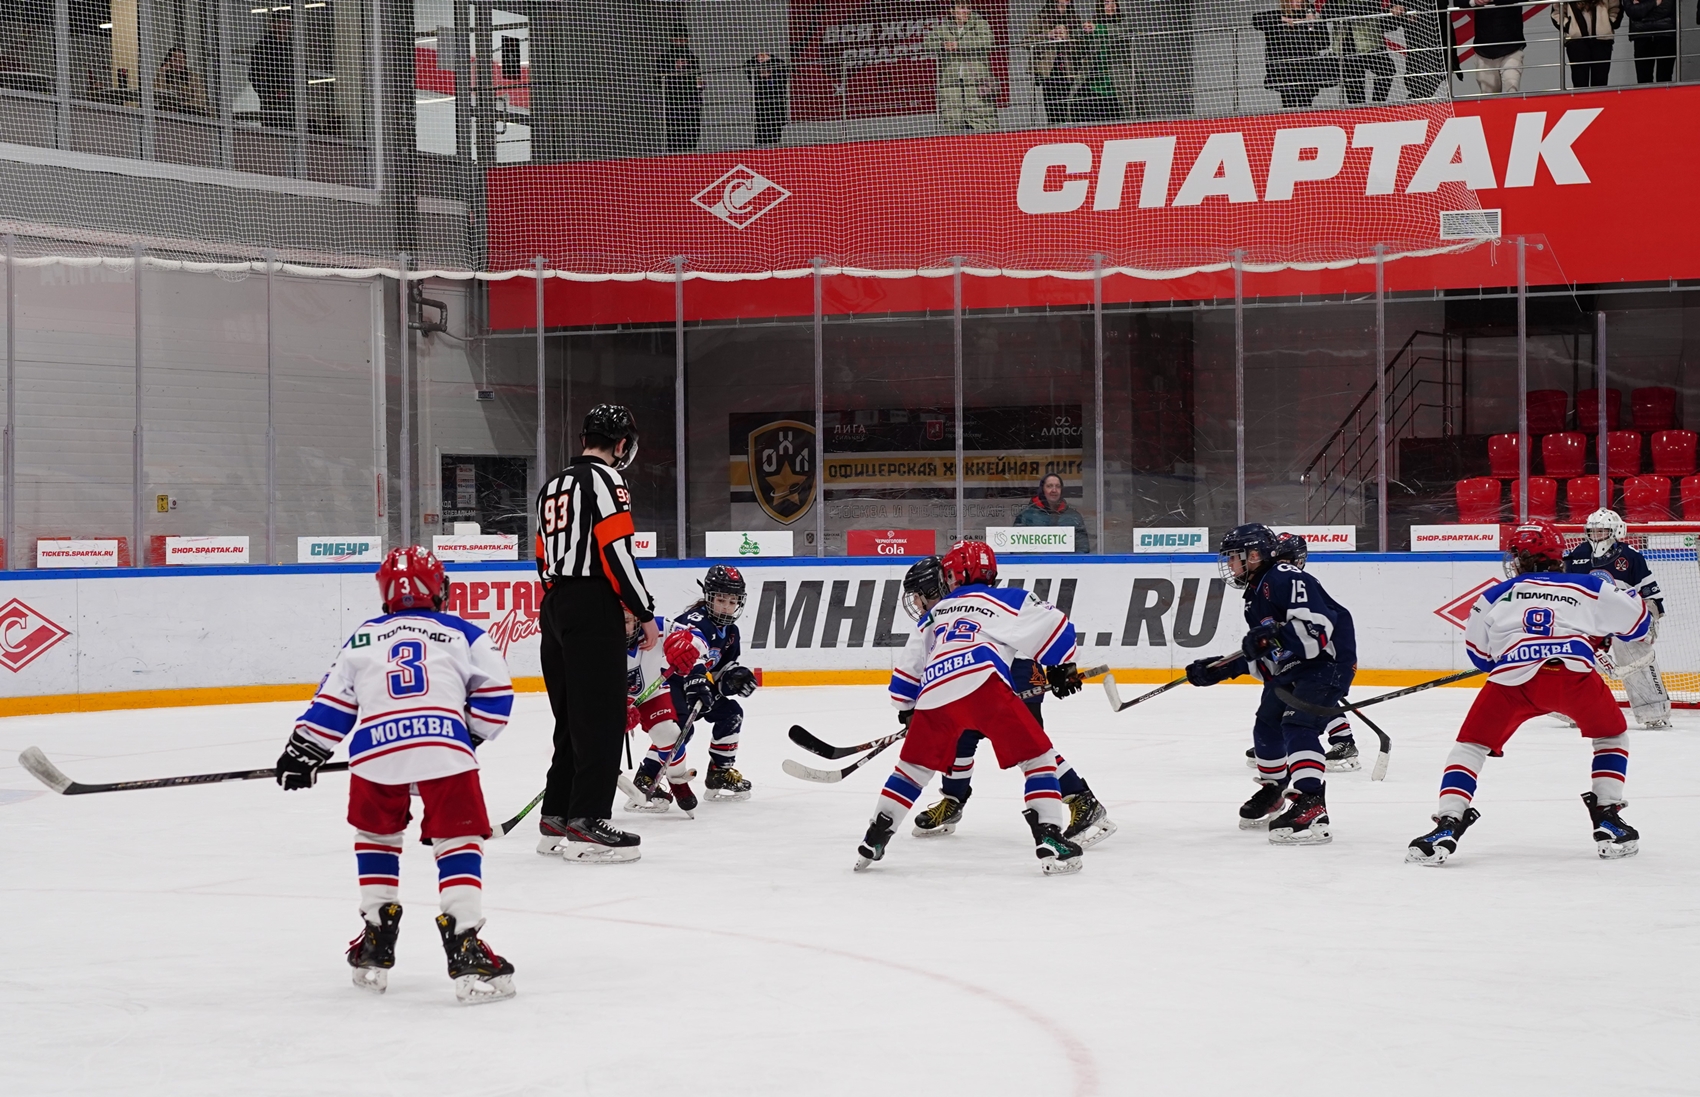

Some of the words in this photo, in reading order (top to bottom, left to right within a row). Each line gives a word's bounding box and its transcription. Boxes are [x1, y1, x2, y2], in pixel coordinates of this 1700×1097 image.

[1016, 107, 1604, 214] СПАРТАК
[834, 424, 866, 434] ЛИГА
[828, 462, 937, 479] ОФИЦЕРСКАЯ
[943, 456, 1040, 477] ХККЕЙНАЯ
[544, 493, 570, 534] 93
[829, 504, 886, 519] МОСКВА
[1010, 534, 1067, 545] SYNERGETIC
[1140, 533, 1202, 546] СИБУР
[1416, 534, 1494, 542] SHOP.SPARTAK.RU
[171, 546, 244, 554] SHOP.SPARTAK.RU
[310, 543, 370, 556] СИБУР
[877, 544, 905, 555] Cola
[399, 577, 411, 595] 3
[1290, 579, 1308, 603] 15
[446, 581, 545, 620] АРТА
[1516, 592, 1579, 607] ПОЛИПЛАСТ
[377, 624, 456, 644] ПОЛИПЛАСТ
[1506, 643, 1573, 662] МОСКВА
[386, 638, 429, 699] 3
[920, 652, 975, 687] МОСКВА
[1649, 665, 1663, 695] BAUER
[650, 708, 672, 720] CCM
[370, 717, 455, 746] МОСКВА
